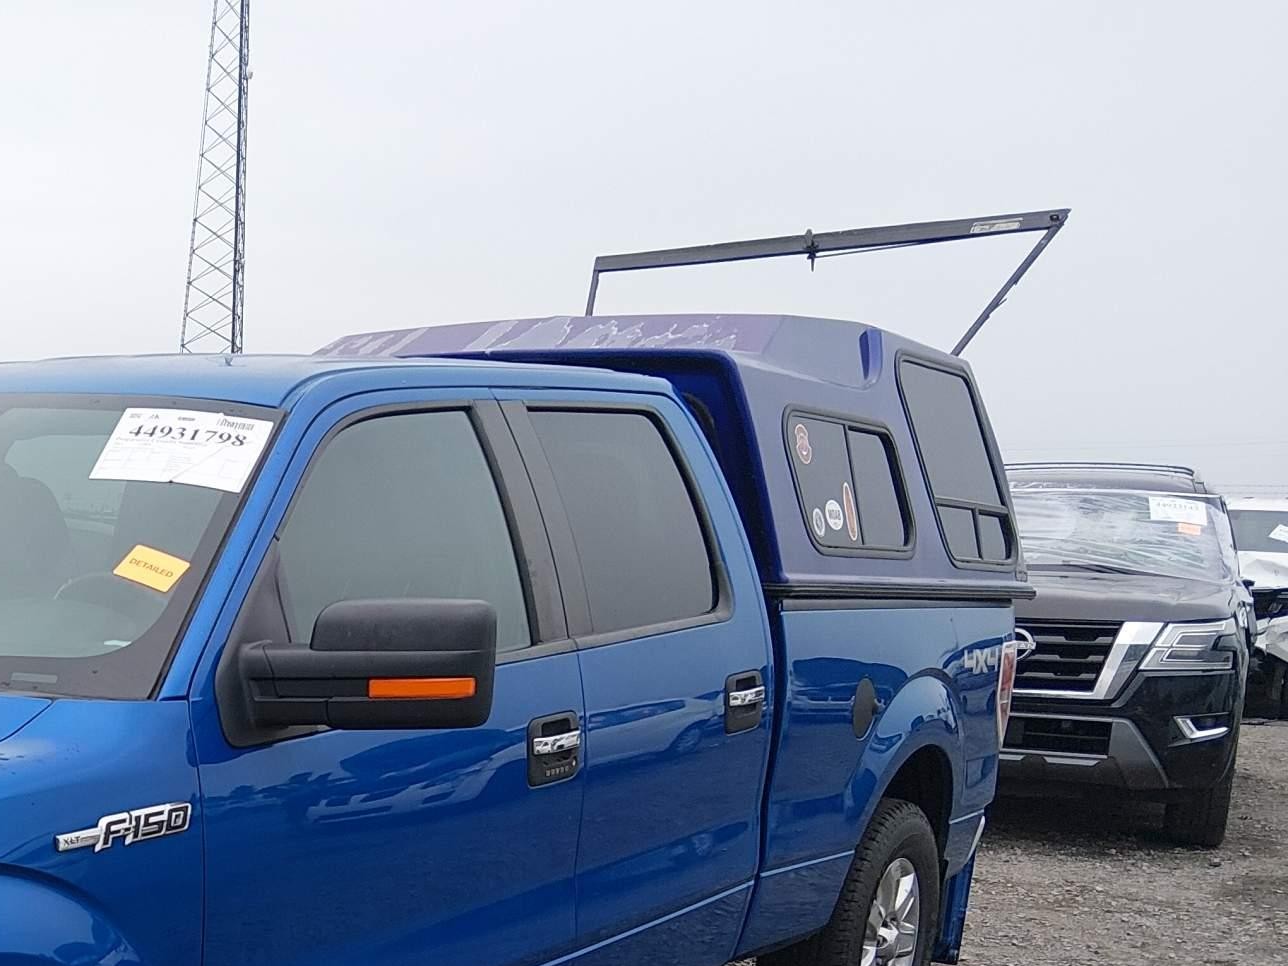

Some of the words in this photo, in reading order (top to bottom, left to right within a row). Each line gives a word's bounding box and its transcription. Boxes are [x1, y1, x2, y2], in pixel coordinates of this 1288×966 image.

[129, 424, 248, 447] 44931798
[128, 558, 174, 578] DETAILED
[96, 803, 191, 851] F-150
[62, 835, 81, 847] XLT
